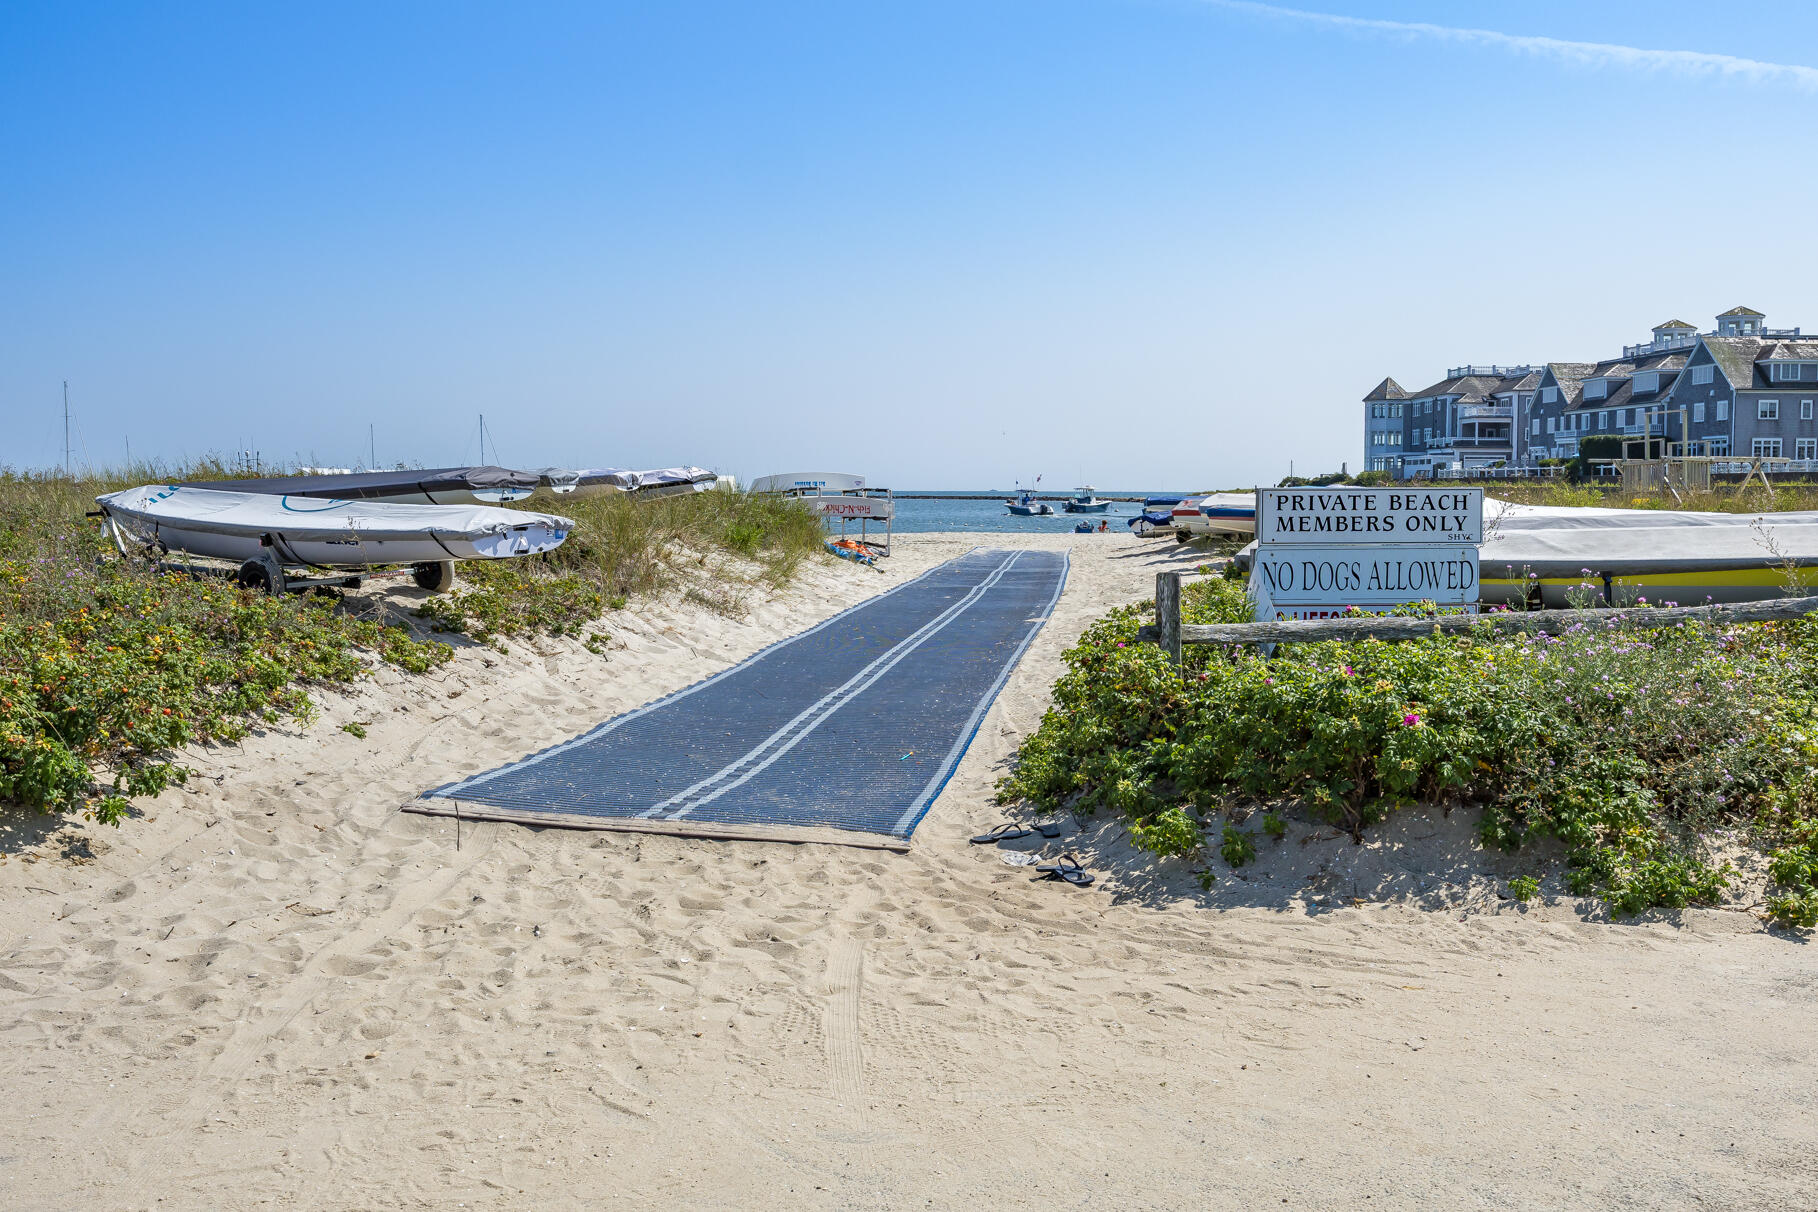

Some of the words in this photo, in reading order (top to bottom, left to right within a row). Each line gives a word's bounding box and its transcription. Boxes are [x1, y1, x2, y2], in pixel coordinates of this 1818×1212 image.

[1276, 494, 1377, 511] PRIVATE
[1389, 494, 1468, 511] BEACH
[1276, 515, 1395, 532] MEMBERS
[1405, 515, 1468, 532] ONLY
[1447, 533, 1473, 541] SHYC
[1262, 561, 1294, 591] NO
[1302, 561, 1361, 591] DOGS
[1367, 560, 1474, 591] ALLOWED
